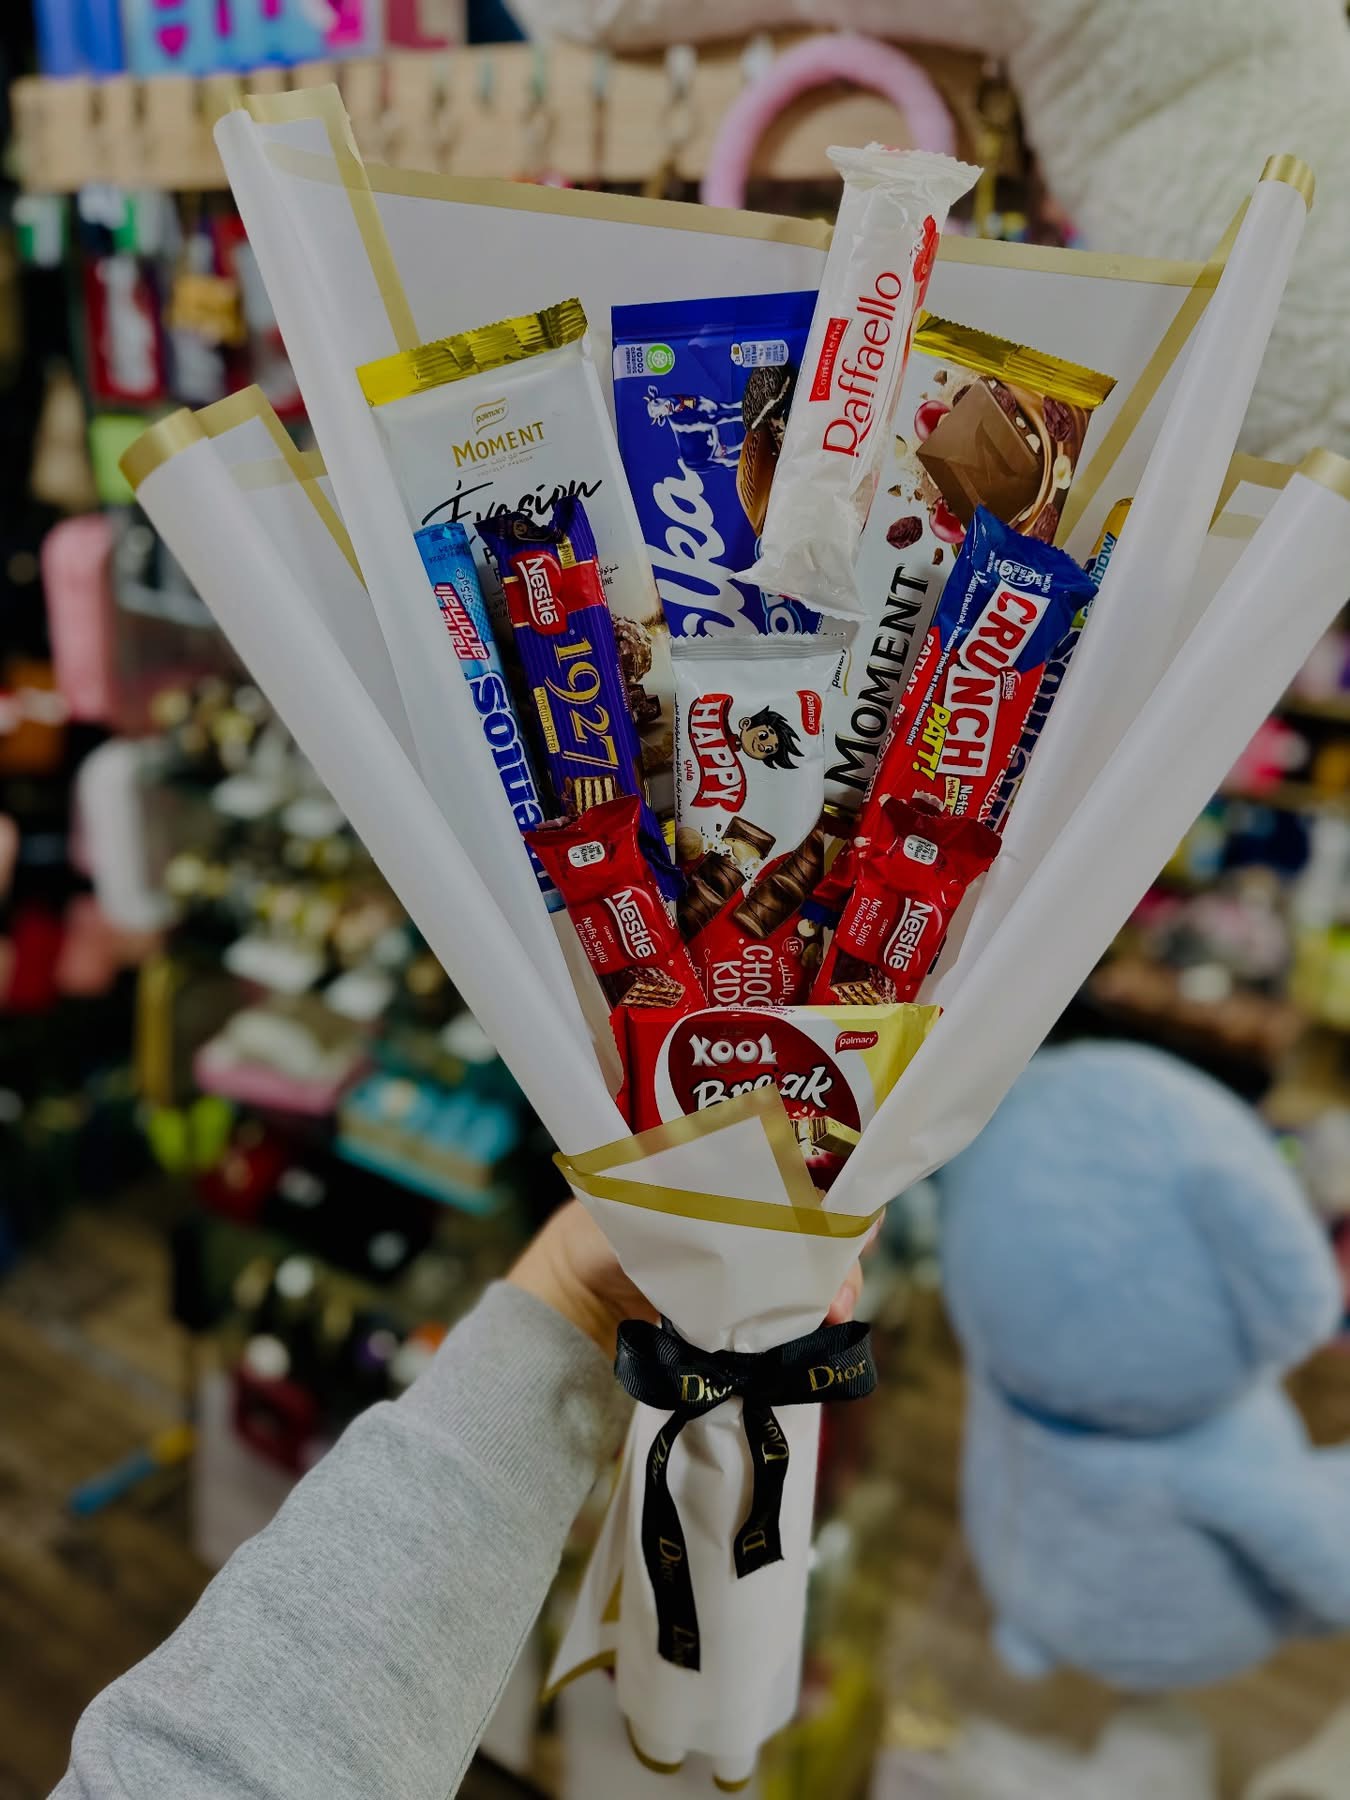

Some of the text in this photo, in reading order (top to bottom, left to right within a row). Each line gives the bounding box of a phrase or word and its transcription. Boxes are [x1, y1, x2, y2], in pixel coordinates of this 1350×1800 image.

[822, 272, 902, 458] Raffaello
[452, 421, 546, 468] MOMENT
[436, 584, 489, 660] aromalı
[526, 557, 560, 626] Nestlé
[824, 565, 931, 791] MOMENT
[902, 633, 937, 696] PATLAT
[941, 591, 1037, 773] CRUNCH
[544, 637, 620, 770] 1927
[804, 695, 816, 731] palmary
[684, 760, 695, 781] هابي
[691, 700, 742, 803] HAPPY
[912, 702, 952, 780] PATT!
[955, 785, 973, 816] Nefis
[582, 917, 608, 963] Nefis Sütlü
[613, 889, 656, 958] Nestlé
[848, 897, 870, 937] Çikolatalı
[856, 898, 882, 947] Nefis Sütlü
[888, 900, 934, 972] Nestlé
[777, 957, 795, 995] بالحليب
[839, 1034, 875, 1047] palmary
[808, 1361, 866, 1392] Dior
